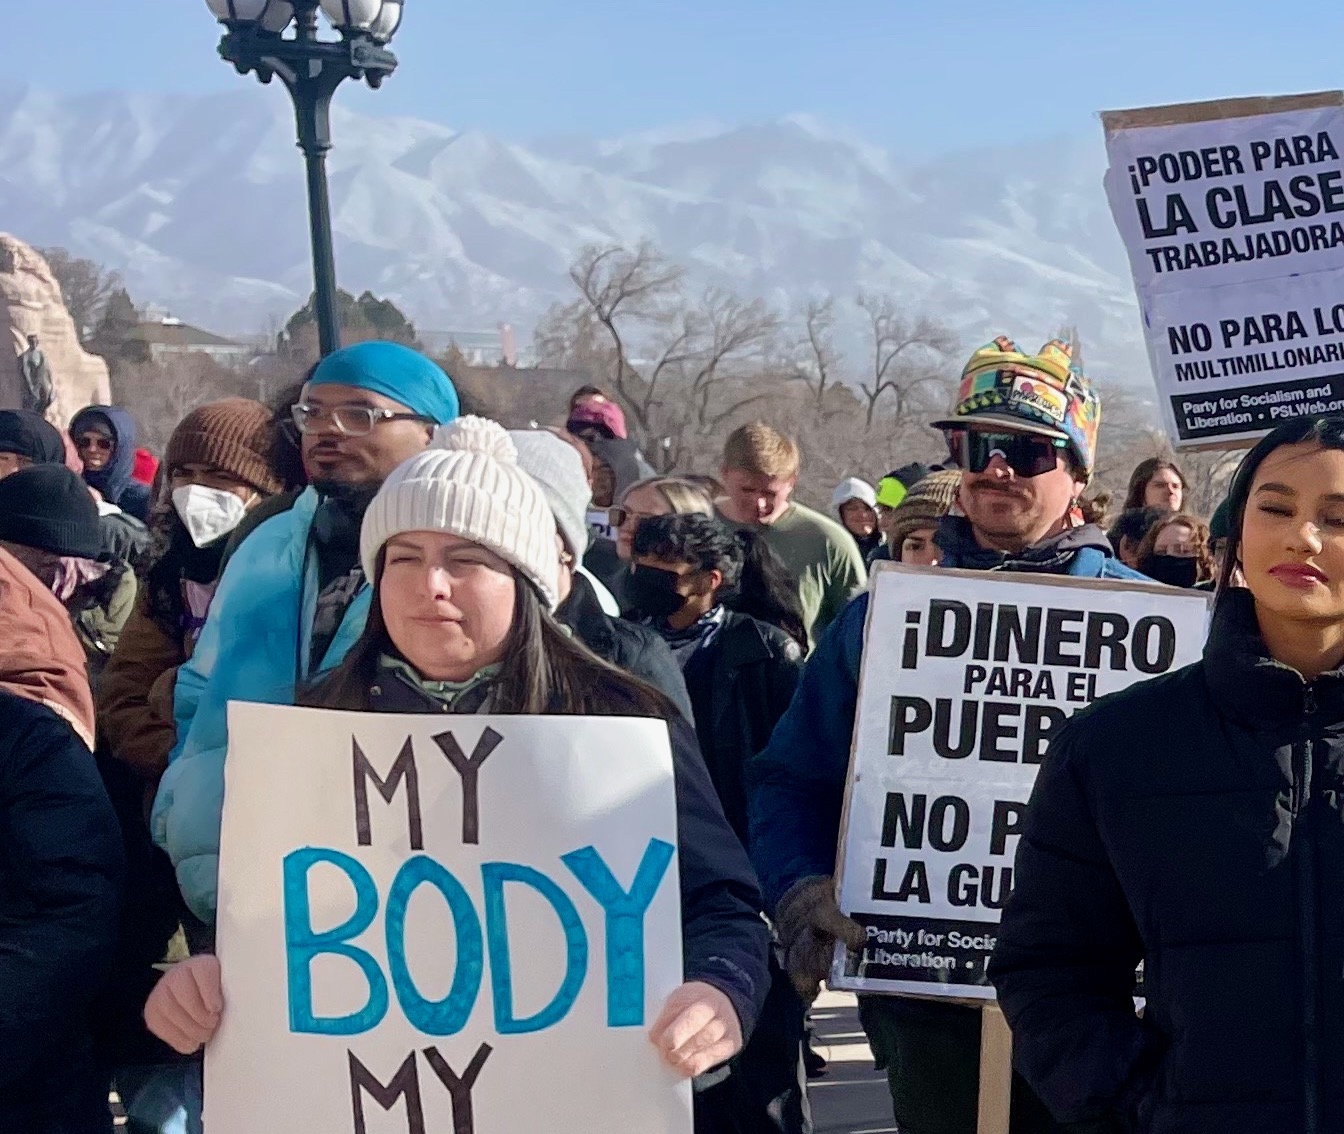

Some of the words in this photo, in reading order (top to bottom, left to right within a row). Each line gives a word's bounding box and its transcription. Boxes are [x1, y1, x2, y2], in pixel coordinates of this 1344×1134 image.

[1128, 145, 1244, 194] ¡PODER
[1250, 131, 1339, 172] PARA
[1136, 194, 1198, 239] LA
[1168, 323, 1212, 354] NO
[1220, 311, 1308, 348] PARA
[1183, 401, 1217, 415] Party
[1219, 398, 1238, 410] for
[1240, 390, 1304, 408] Socialism
[1306, 384, 1331, 399] and
[1186, 412, 1252, 430] Liberation
[901, 598, 1176, 673] ¡DINERO
[964, 664, 1056, 700] PARA
[1066, 673, 1102, 702] EL
[351, 726, 504, 850] MY
[881, 791, 969, 853] NO
[872, 858, 931, 904] LA
[282, 837, 675, 1036] BODY
[863, 947, 956, 969] Liberation
[865, 925, 914, 948] Party
[917, 929, 945, 945] for
